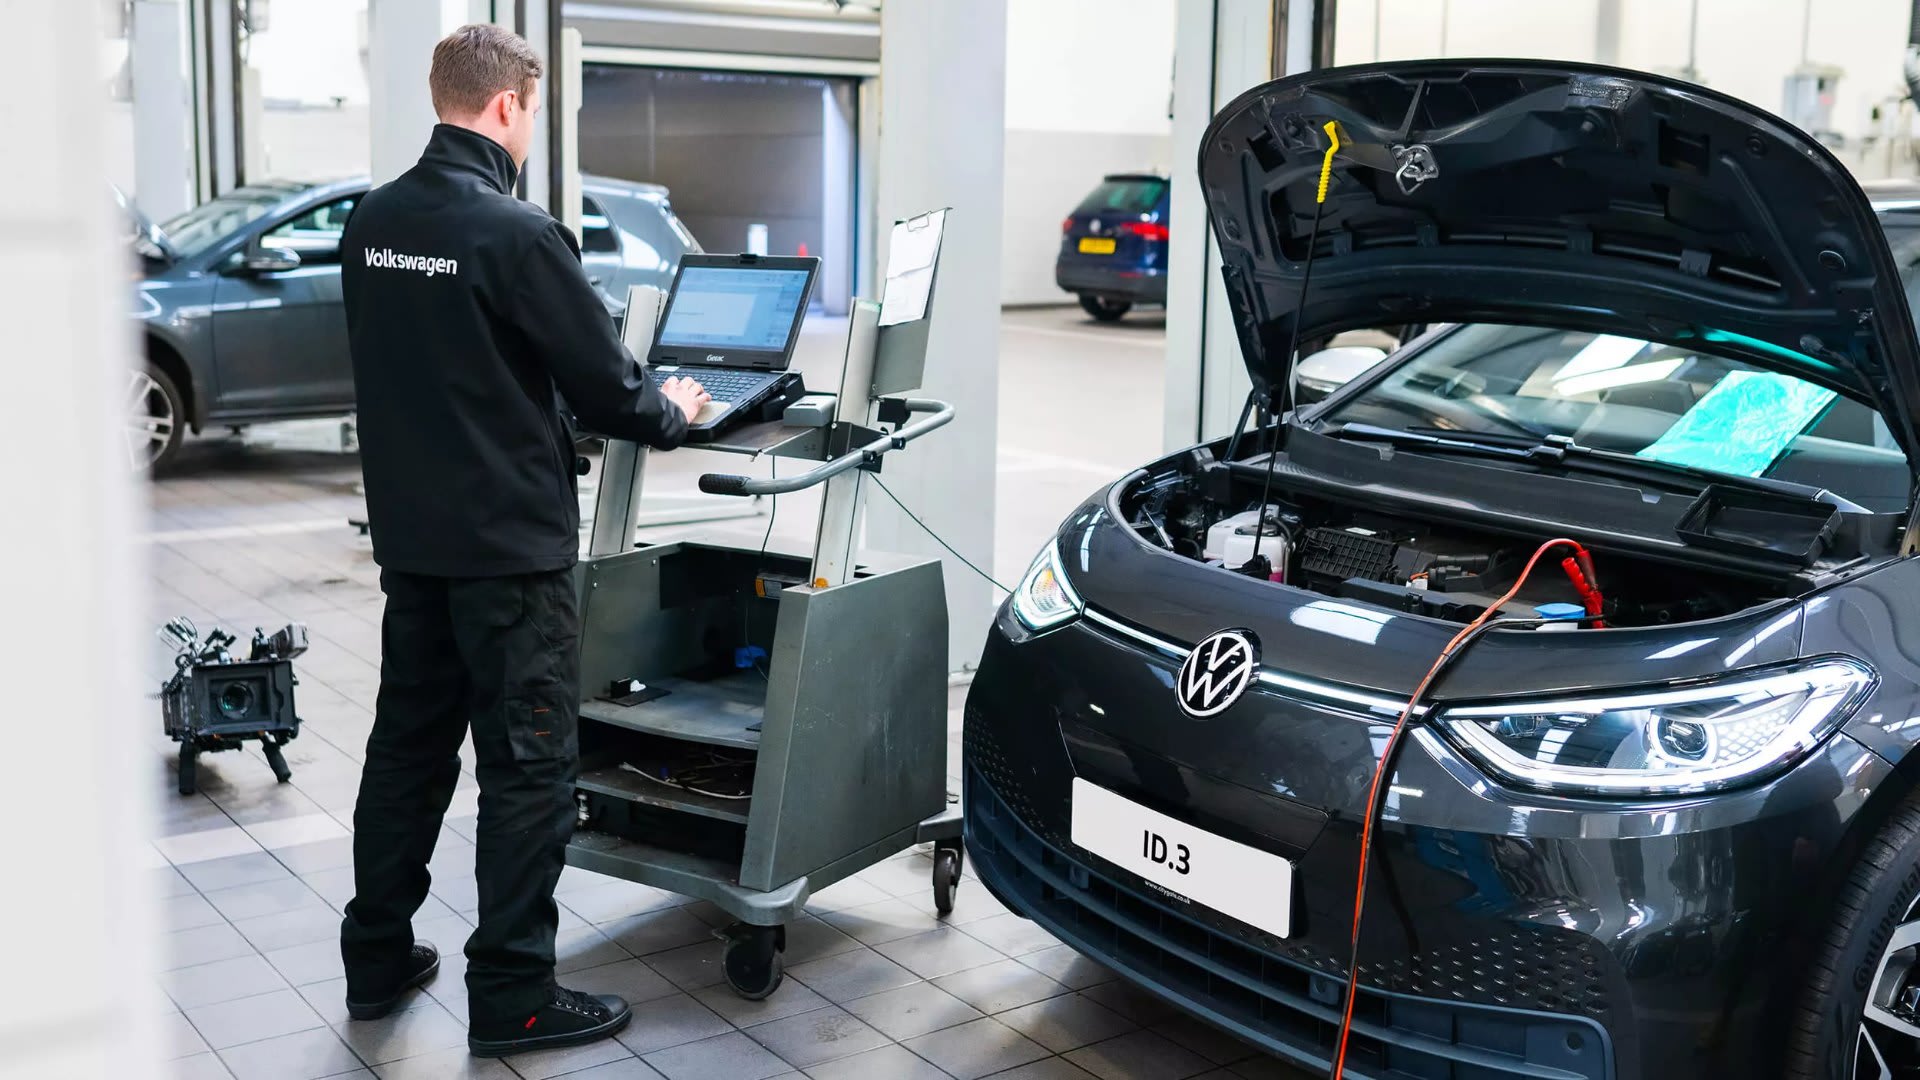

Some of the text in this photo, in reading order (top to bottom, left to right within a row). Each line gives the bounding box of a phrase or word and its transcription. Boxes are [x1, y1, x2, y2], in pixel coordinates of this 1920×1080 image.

[364, 247, 458, 277] Volkswagen
[706, 353, 725, 362] Getac
[1143, 829, 1190, 875] ID.3
